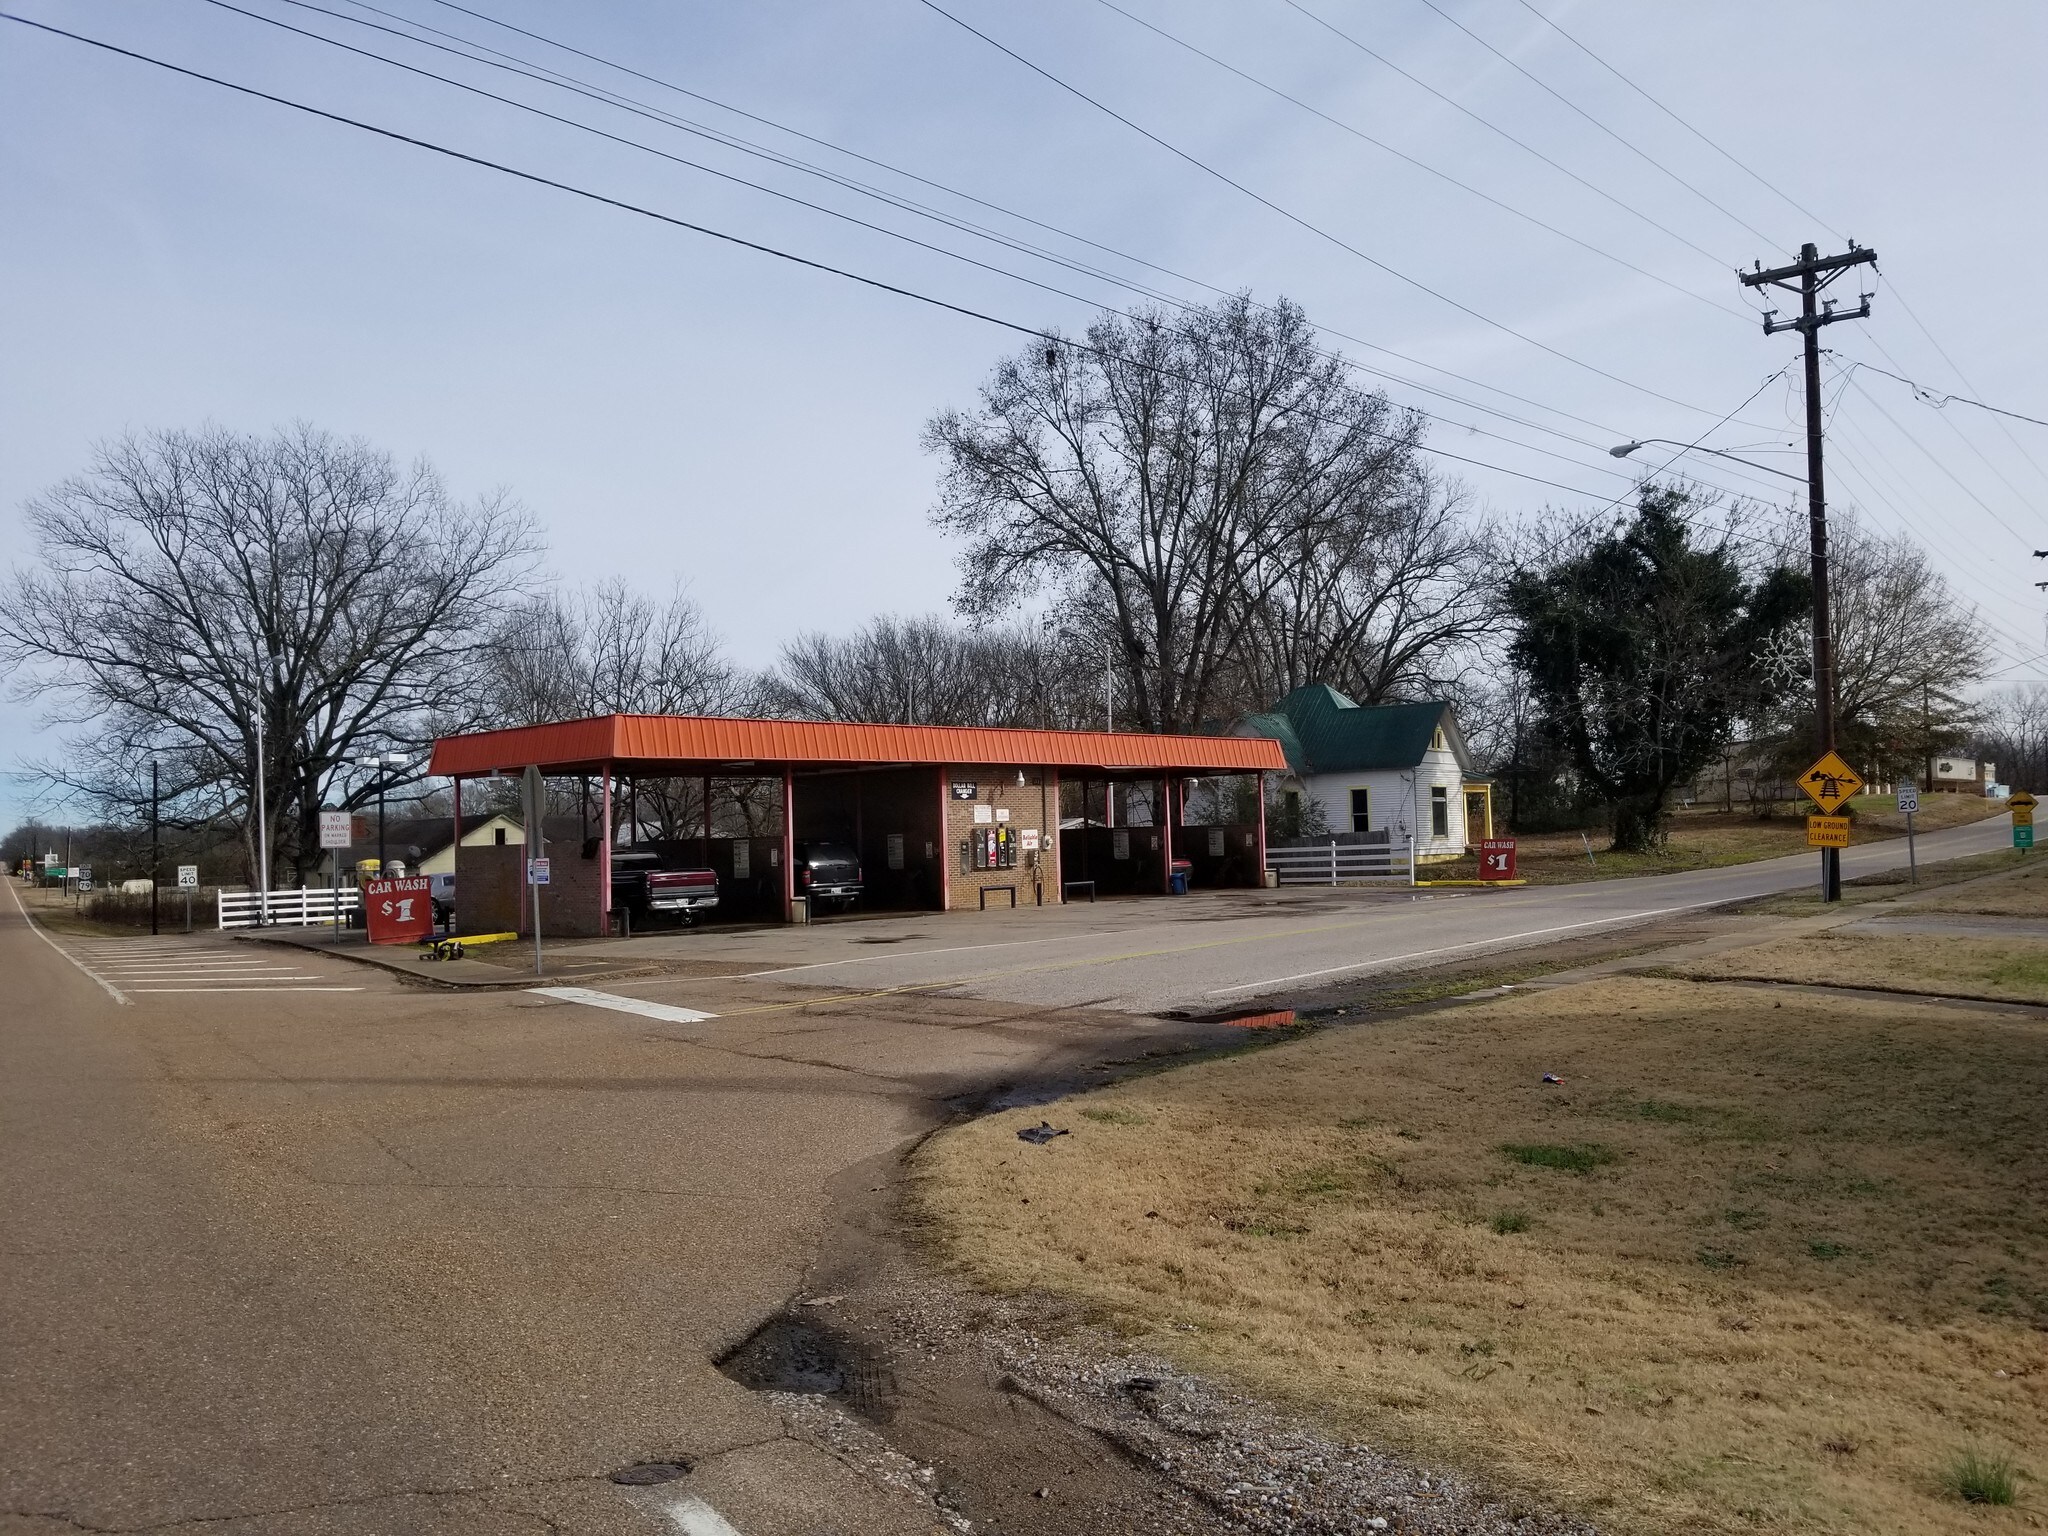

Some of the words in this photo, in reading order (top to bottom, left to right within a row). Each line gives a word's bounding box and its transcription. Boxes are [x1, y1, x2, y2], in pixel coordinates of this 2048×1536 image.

[1900, 800, 1916, 809] 20
[1810, 833, 1846, 842] CLEARANCE
[1487, 854, 1508, 870] $1
[180, 876, 195, 884] 40
[368, 882, 392, 894] CAR
[395, 879, 428, 891] WASH
[381, 899, 415, 921] $1
